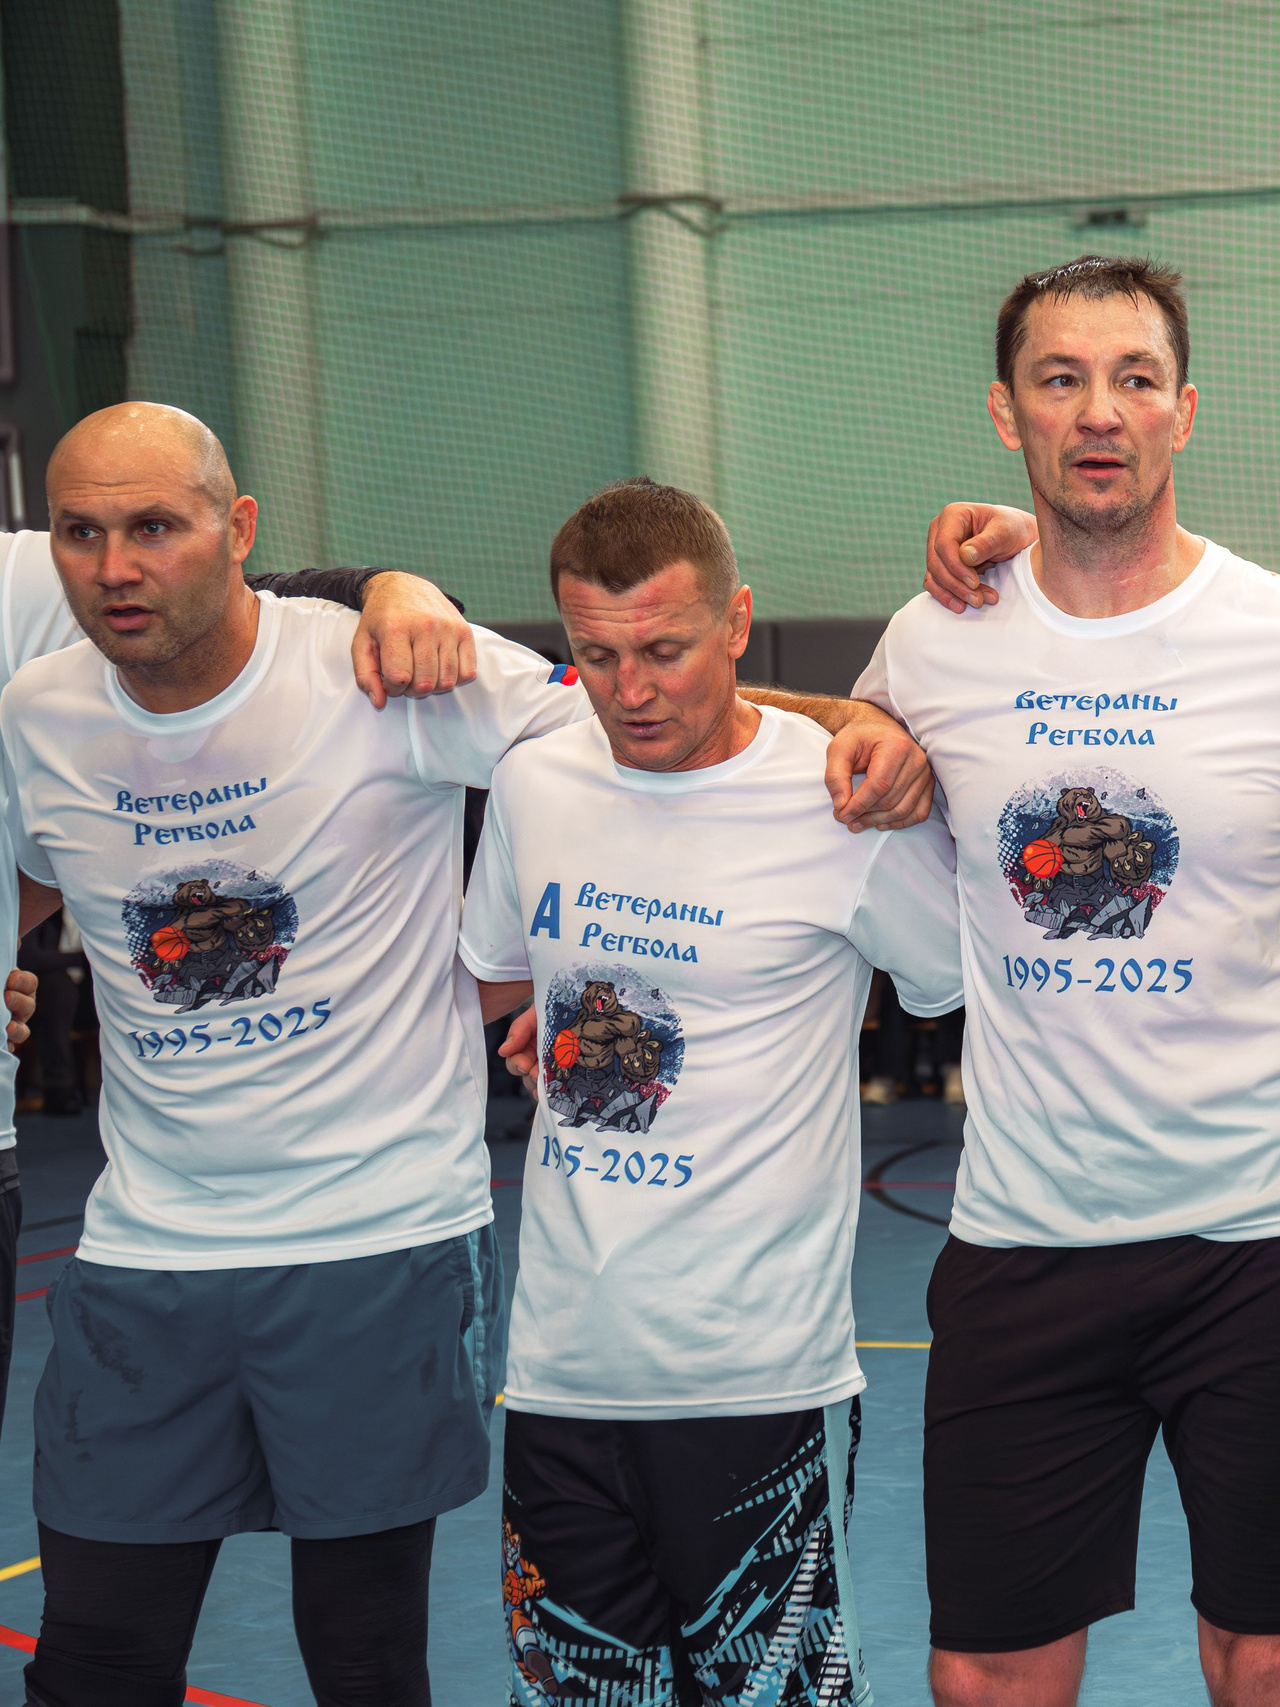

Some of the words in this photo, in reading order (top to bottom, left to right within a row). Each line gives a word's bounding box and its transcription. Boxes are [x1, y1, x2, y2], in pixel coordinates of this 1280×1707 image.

[1014, 690, 1178, 717] Ветераны
[1025, 721, 1155, 746] Регбола
[113, 777, 267, 814] Ветераны
[133, 814, 257, 845] Регбола
[574, 882, 724, 926] Ветераны
[579, 922, 698, 963] Регбола
[1003, 954, 1194, 994] 1995-2025
[128, 997, 331, 1058] 1995-2025
